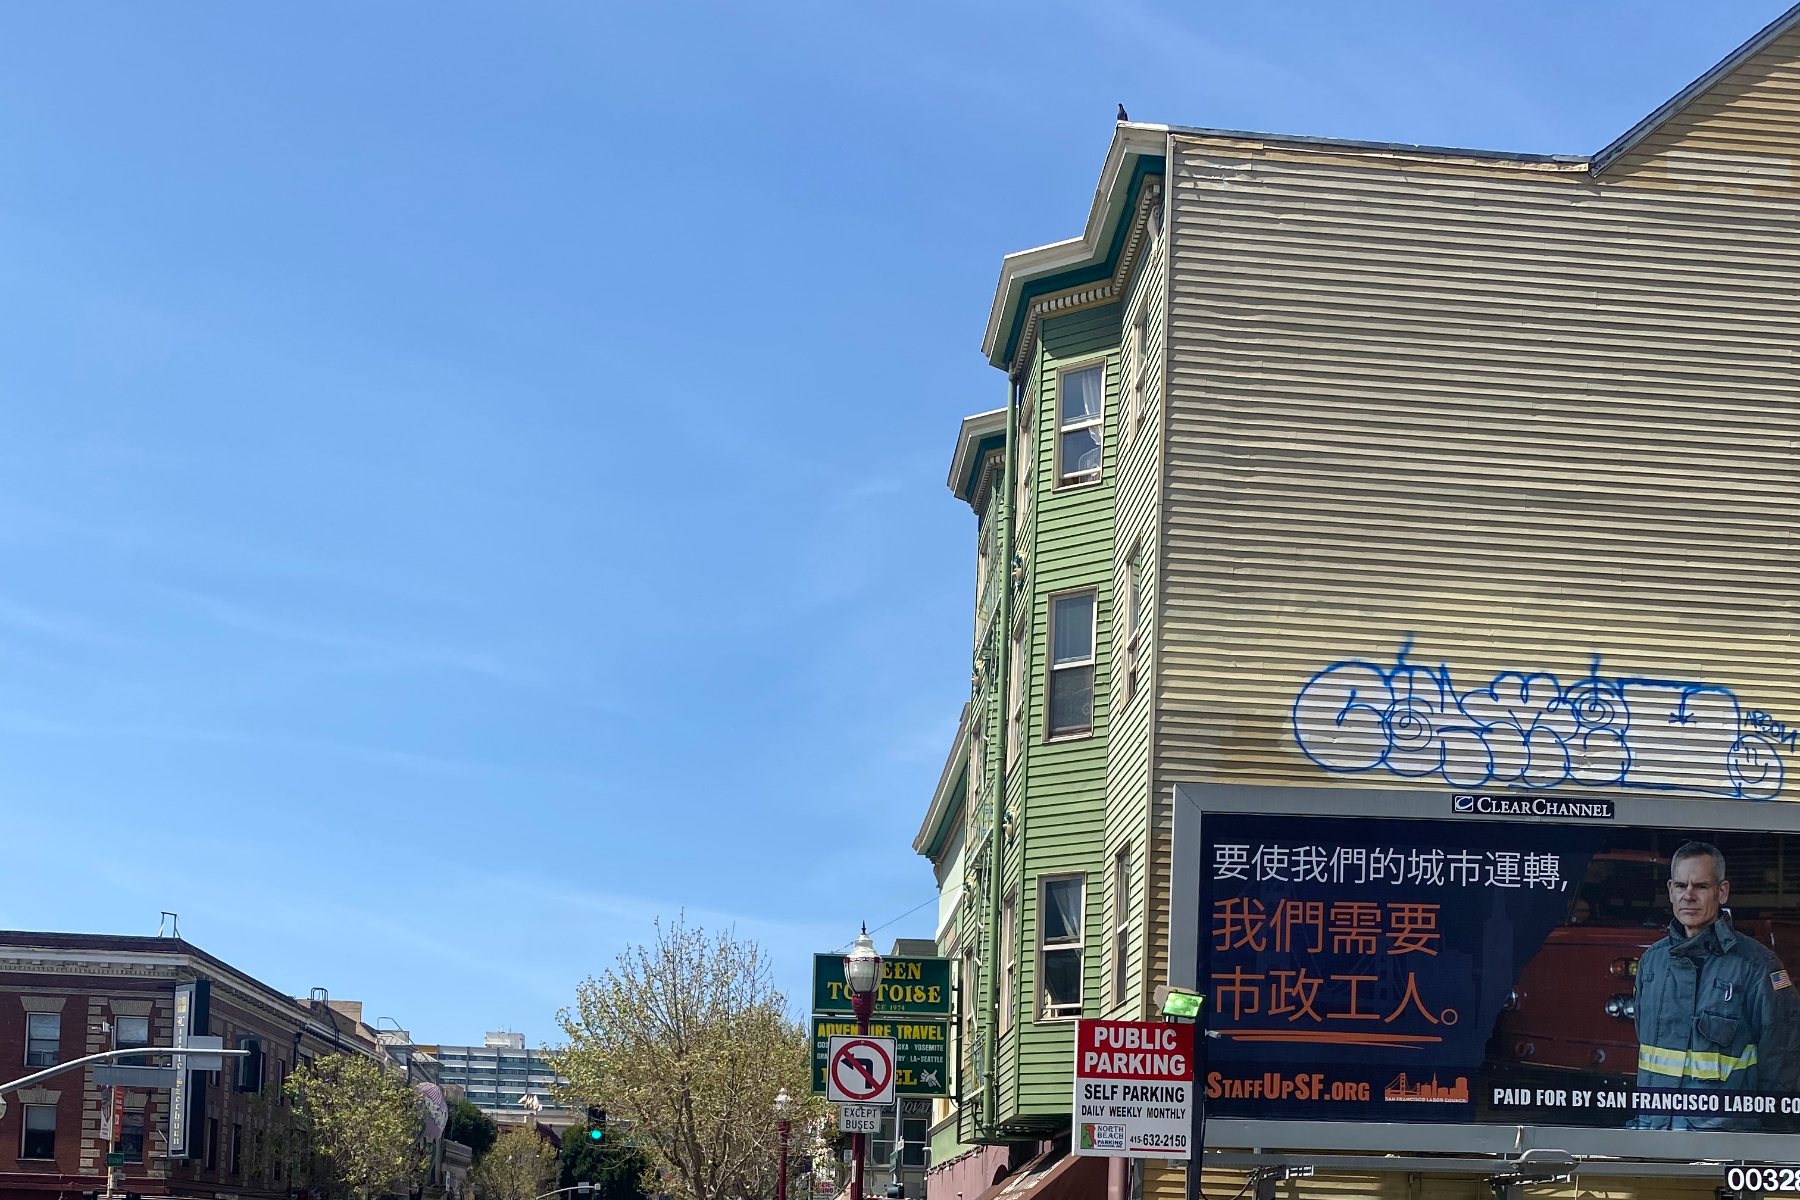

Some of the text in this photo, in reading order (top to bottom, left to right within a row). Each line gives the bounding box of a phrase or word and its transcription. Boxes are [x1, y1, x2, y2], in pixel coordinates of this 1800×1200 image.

[1211, 897, 1441, 956] 我們需要
[1210, 965, 1459, 1026] 市政工人。
[817, 1023, 944, 1040] ADVENURE TRAVEL
[1094, 1026, 1177, 1050] PUBLIC
[914, 1043, 944, 1052] YOSEMITE
[910, 1055, 943, 1063] LA-SEATTLE
[1084, 1052, 1186, 1076] PARKING
[1084, 1083, 1185, 1103] SELF PARKING
[1493, 1088, 1531, 1106] PAID
[1536, 1089, 1567, 1107] FOR
[1572, 1090, 1592, 1108] BY
[1596, 1091, 1627, 1109] SAN
[1631, 1092, 1719, 1112] FRANCISCO
[1724, 1095, 1776, 1114] LABOR
[844, 1107, 877, 1118] EXCEPT
[1081, 1104, 1186, 1119] DAILY WEEKLY MONTHLY
[845, 1120, 875, 1130] BUSES
[1097, 1125, 1124, 1133] NORTH
[1129, 1133, 1187, 1147] 415-632-2150
